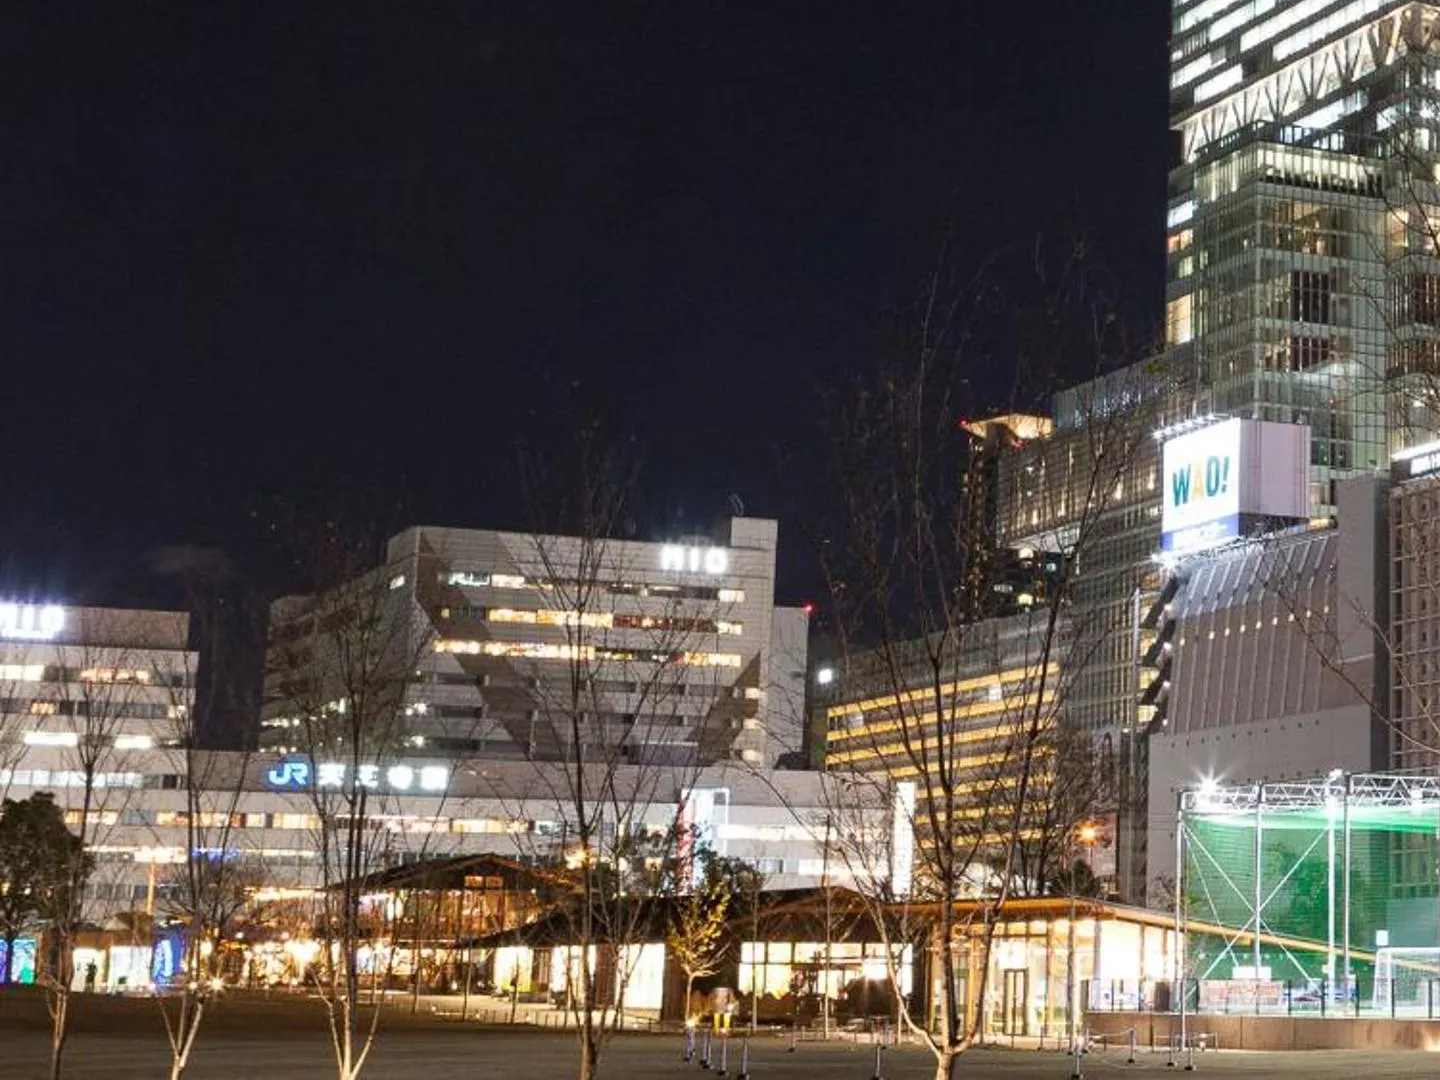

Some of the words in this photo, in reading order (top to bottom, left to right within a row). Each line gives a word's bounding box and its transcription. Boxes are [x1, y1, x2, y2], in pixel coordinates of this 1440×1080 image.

[1172, 455, 1230, 507] WAO!
[661, 545, 728, 574] MIO
[268, 763, 308, 786] JR
[317, 764, 449, 790] 天王
